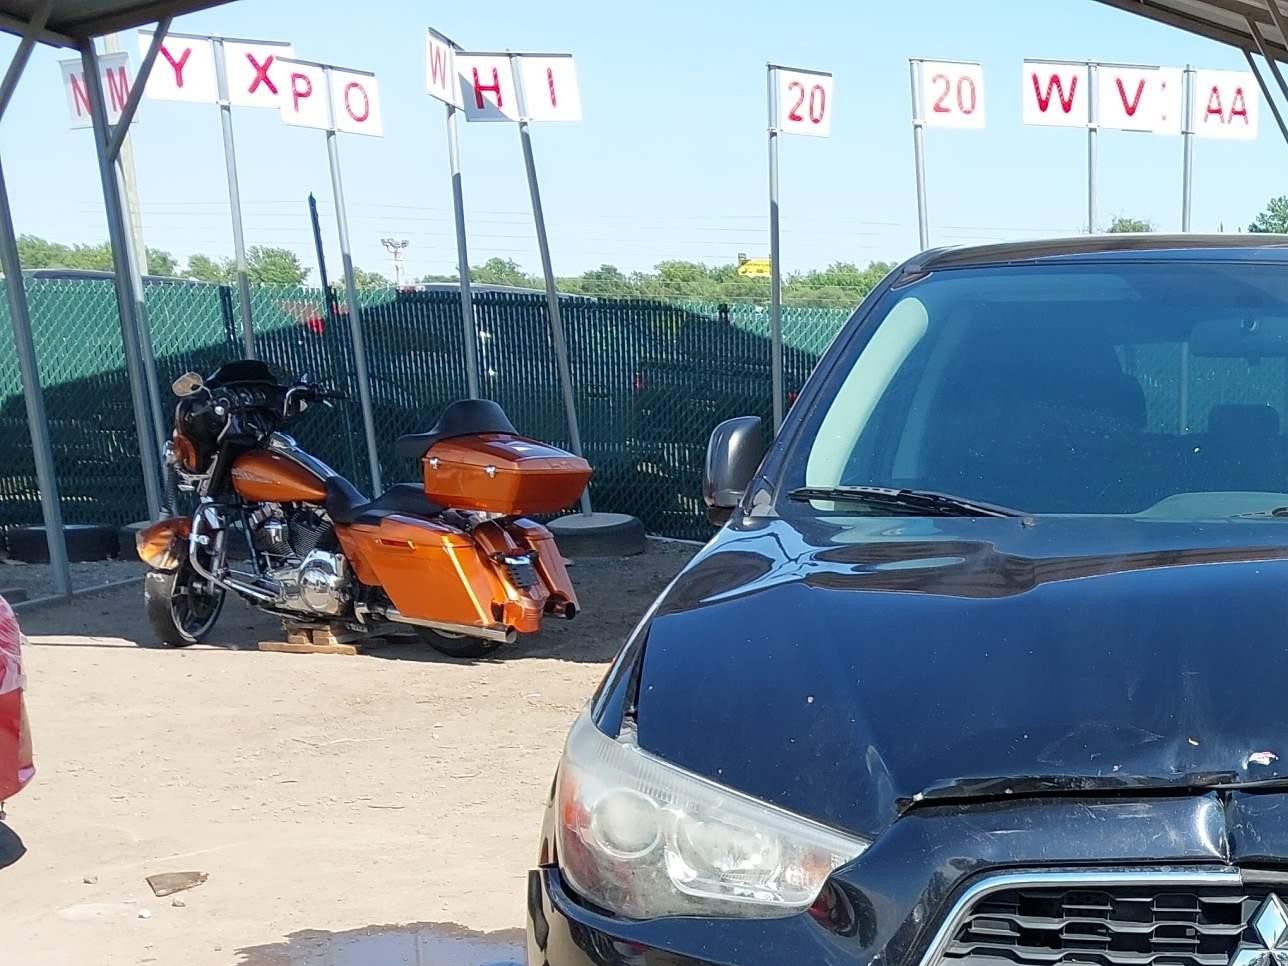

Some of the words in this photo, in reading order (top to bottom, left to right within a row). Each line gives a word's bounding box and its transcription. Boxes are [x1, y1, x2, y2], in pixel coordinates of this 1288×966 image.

[158, 43, 192, 88] Y
[245, 52, 279, 95] X
[428, 39, 447, 90] W
[105, 65, 130, 112] M
[291, 71, 313, 113] P
[472, 66, 503, 110] H
[786, 80, 826, 125] 20
[931, 73, 977, 116] 20
[1031, 73, 1079, 114] W
[1115, 77, 1147, 117] V
[1203, 84, 1249, 125] AA
